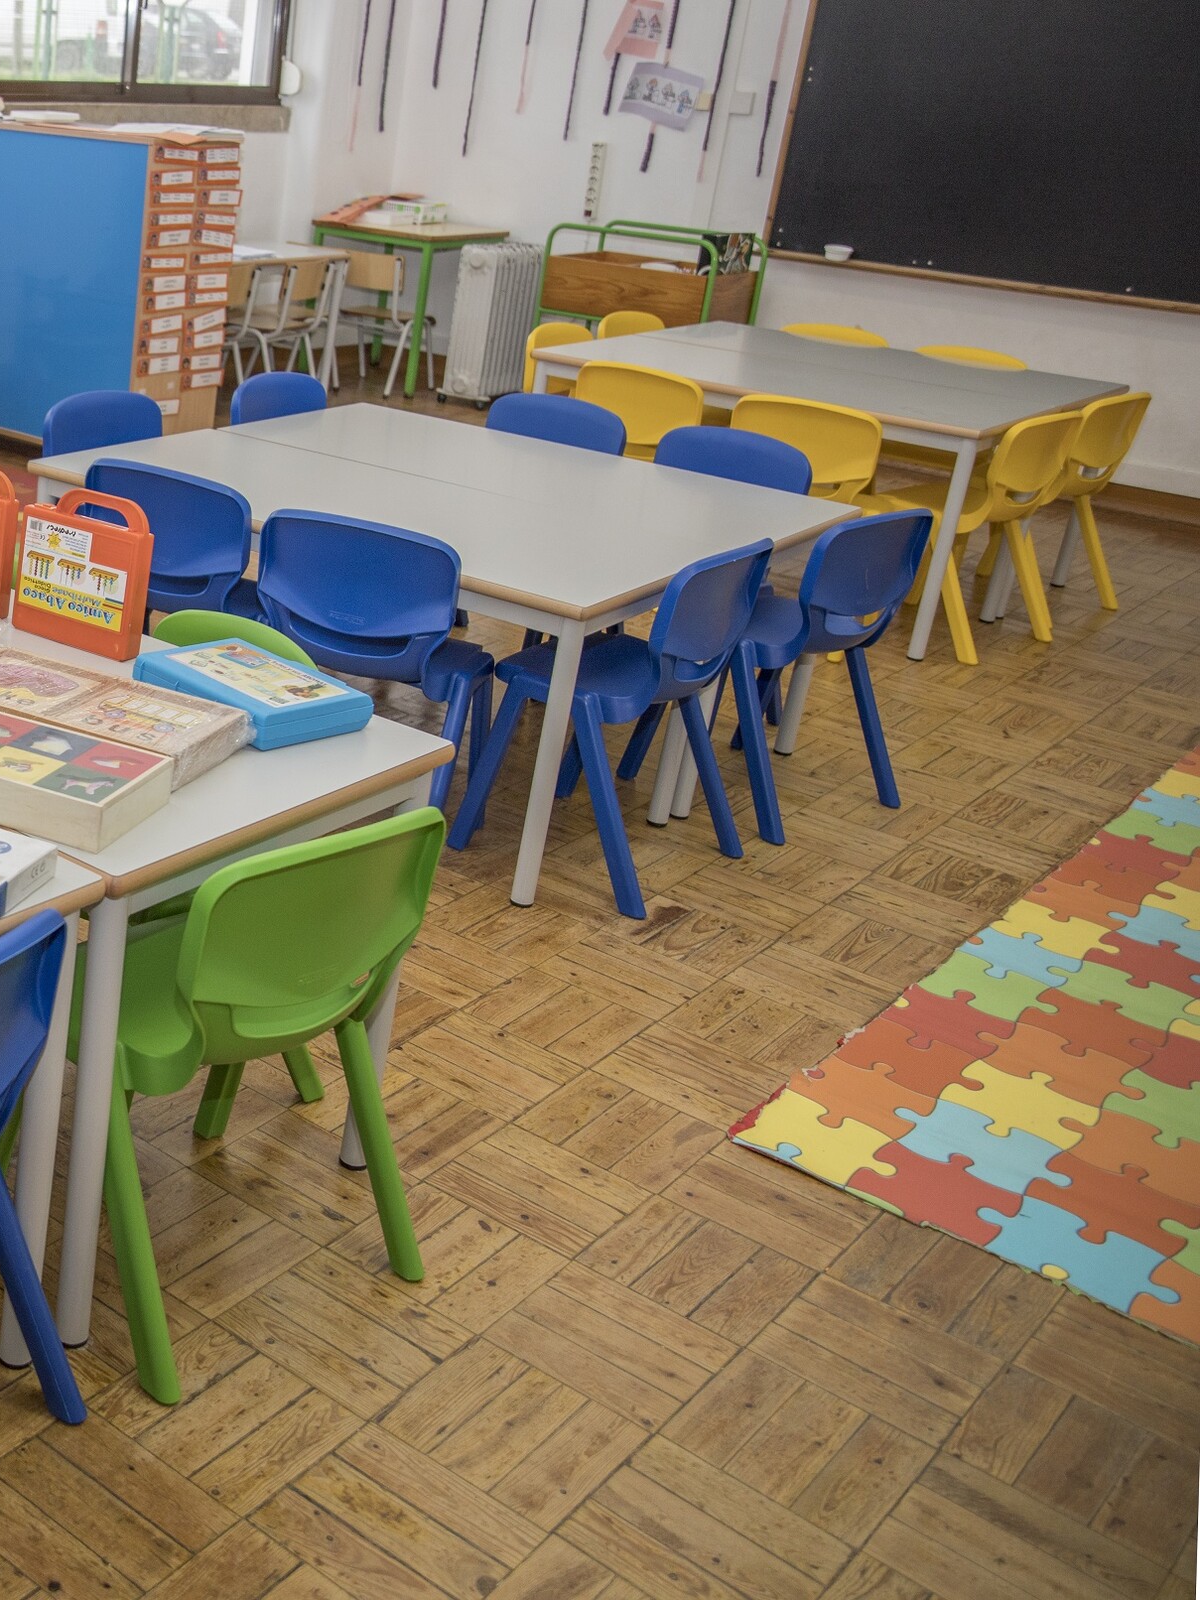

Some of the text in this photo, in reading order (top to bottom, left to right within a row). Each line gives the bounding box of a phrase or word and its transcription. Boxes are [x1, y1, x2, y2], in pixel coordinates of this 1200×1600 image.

[23, 586, 116, 625] Amico Abaco
[52, 586, 101, 608] Multibase
